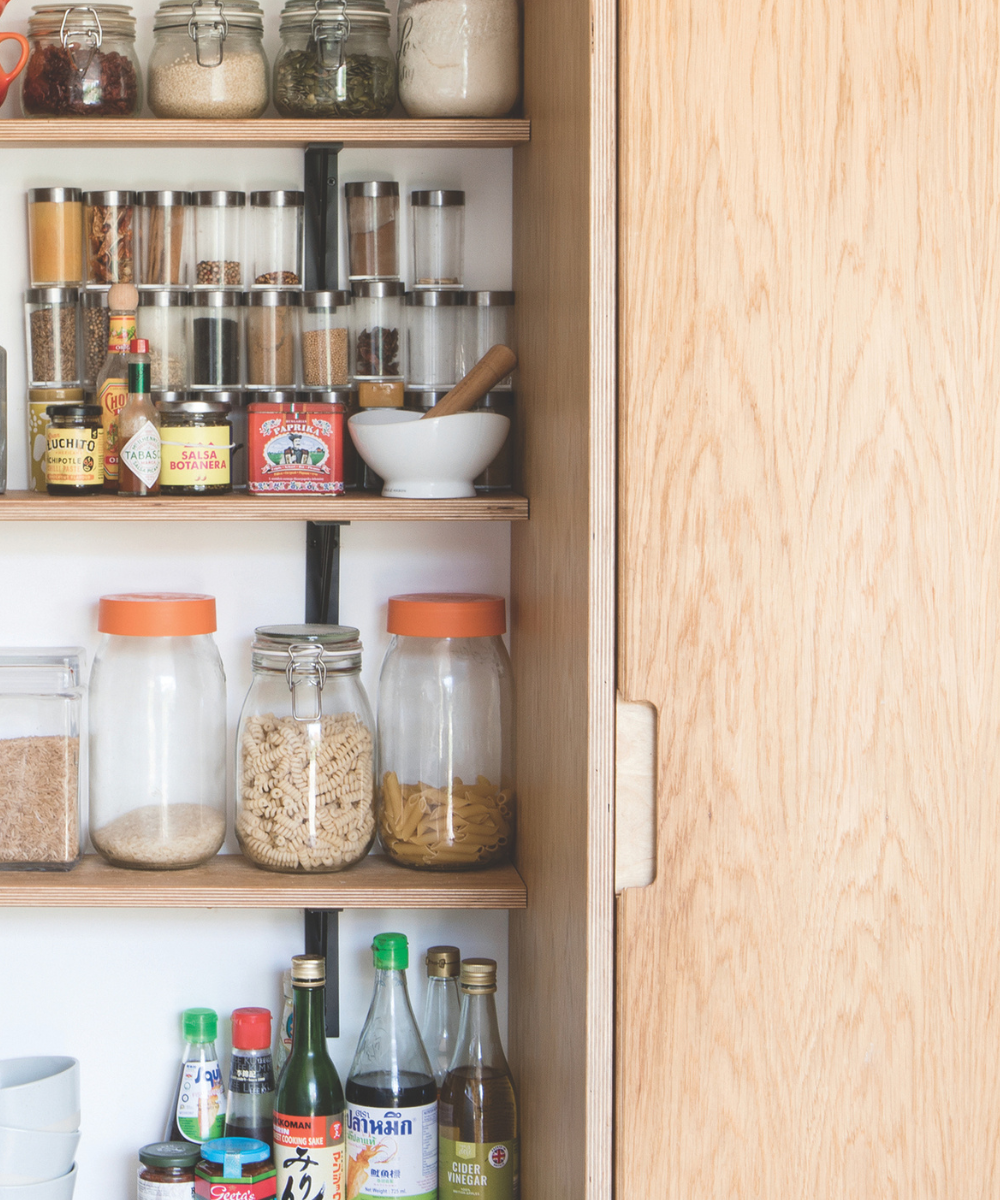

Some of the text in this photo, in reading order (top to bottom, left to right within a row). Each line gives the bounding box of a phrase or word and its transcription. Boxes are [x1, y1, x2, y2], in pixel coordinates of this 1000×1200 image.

[273, 423, 320, 436] PAPRIKA
[47, 438, 96, 452] LUCHITO
[181, 450, 218, 460] SALSA
[170, 460, 227, 470] BOTANERA
[346, 1109, 412, 1135] ปลาหมึก
[282, 1134, 307, 1146] COOKING
[308, 1137, 324, 1146] SAKE
[452, 1161, 481, 1175] CIDER
[447, 1171, 488, 1186] VINEGAR
[210, 1185, 256, 1200] Geeta's
